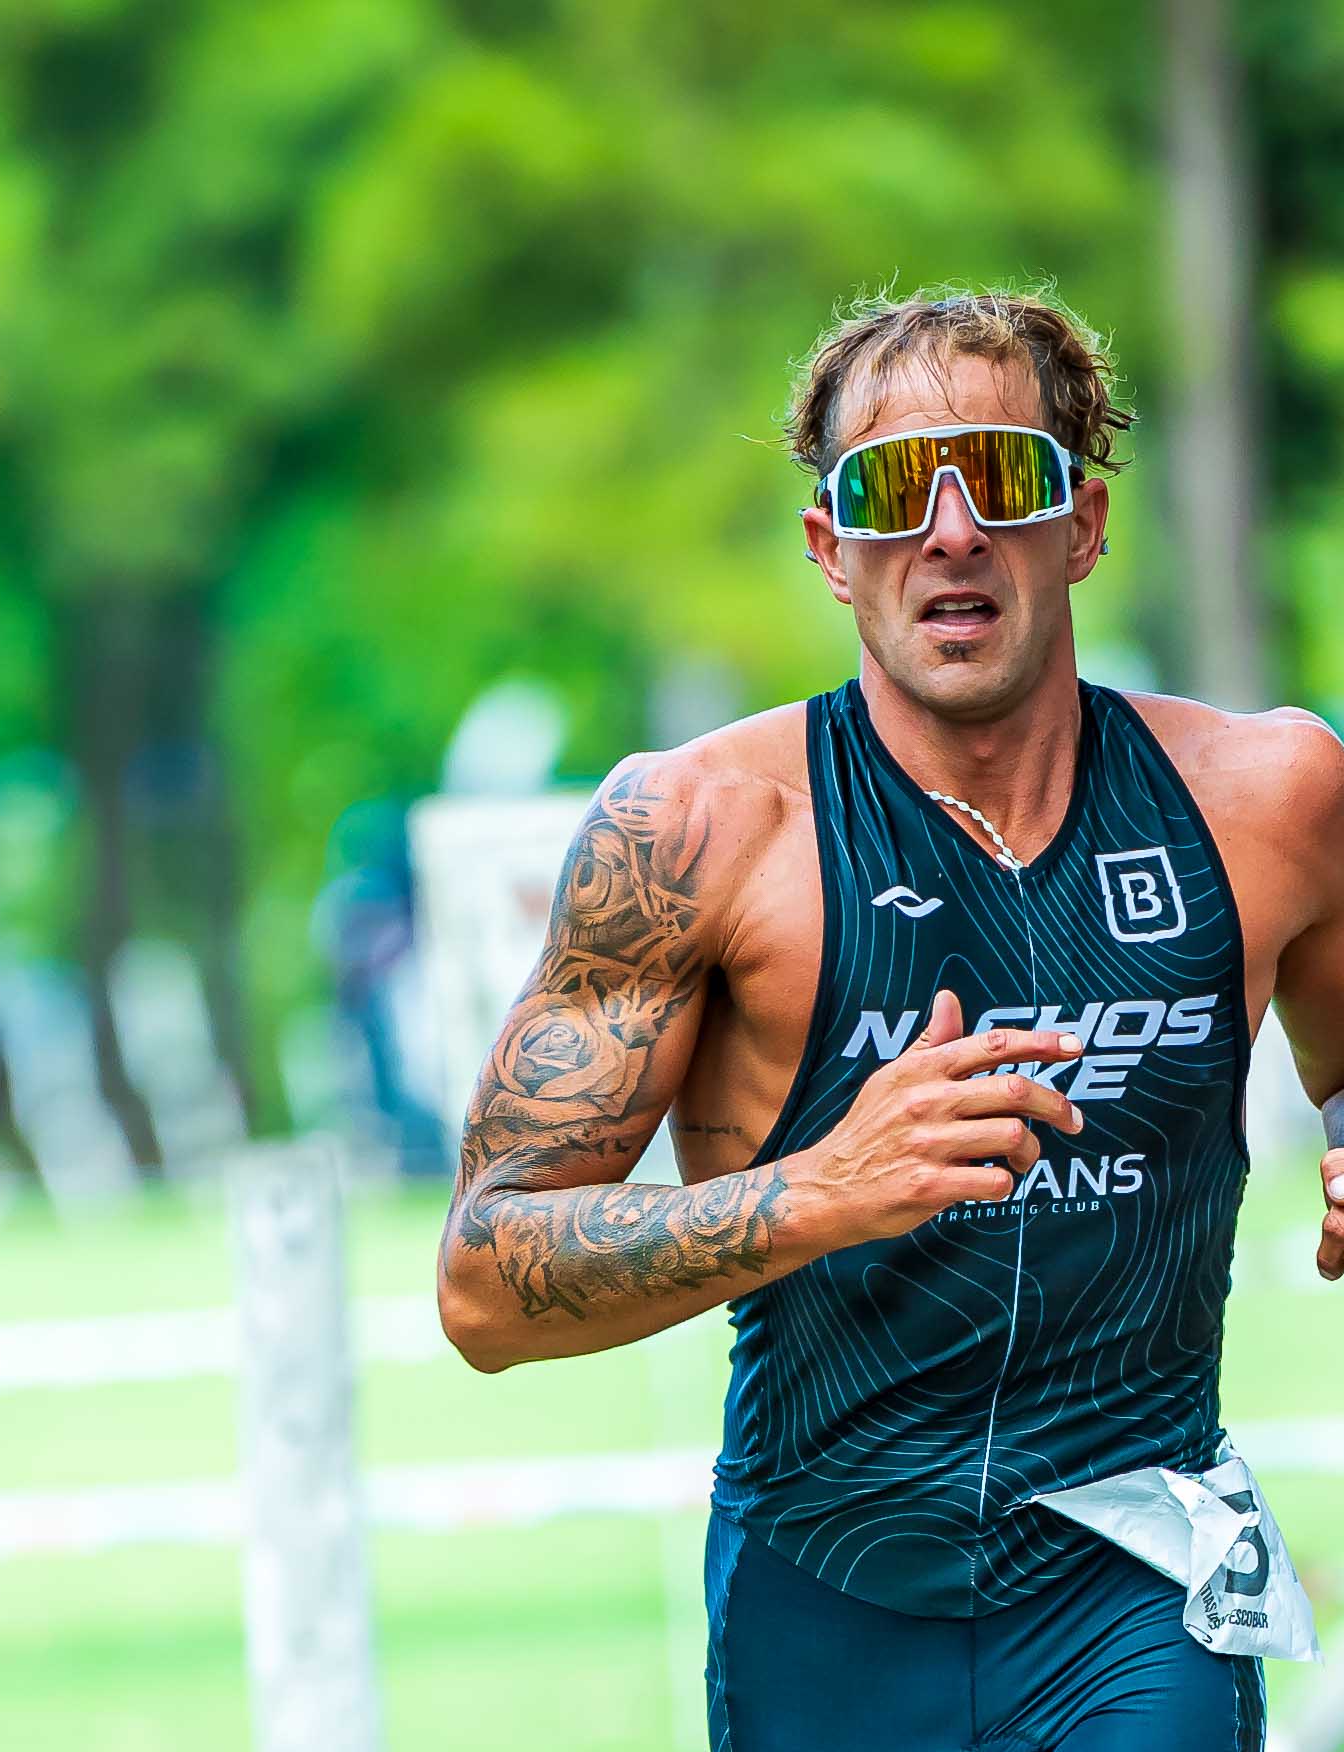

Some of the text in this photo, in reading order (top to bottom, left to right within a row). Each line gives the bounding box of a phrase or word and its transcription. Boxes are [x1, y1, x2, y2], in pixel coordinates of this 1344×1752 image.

[1119, 871, 1162, 920] B
[841, 994, 1219, 1060] NCHOS
[970, 1053, 1144, 1101] KE
[936, 1200, 1100, 1224] TRAINING CLUB
[1228, 1608, 1269, 1629] ESCOBAR
